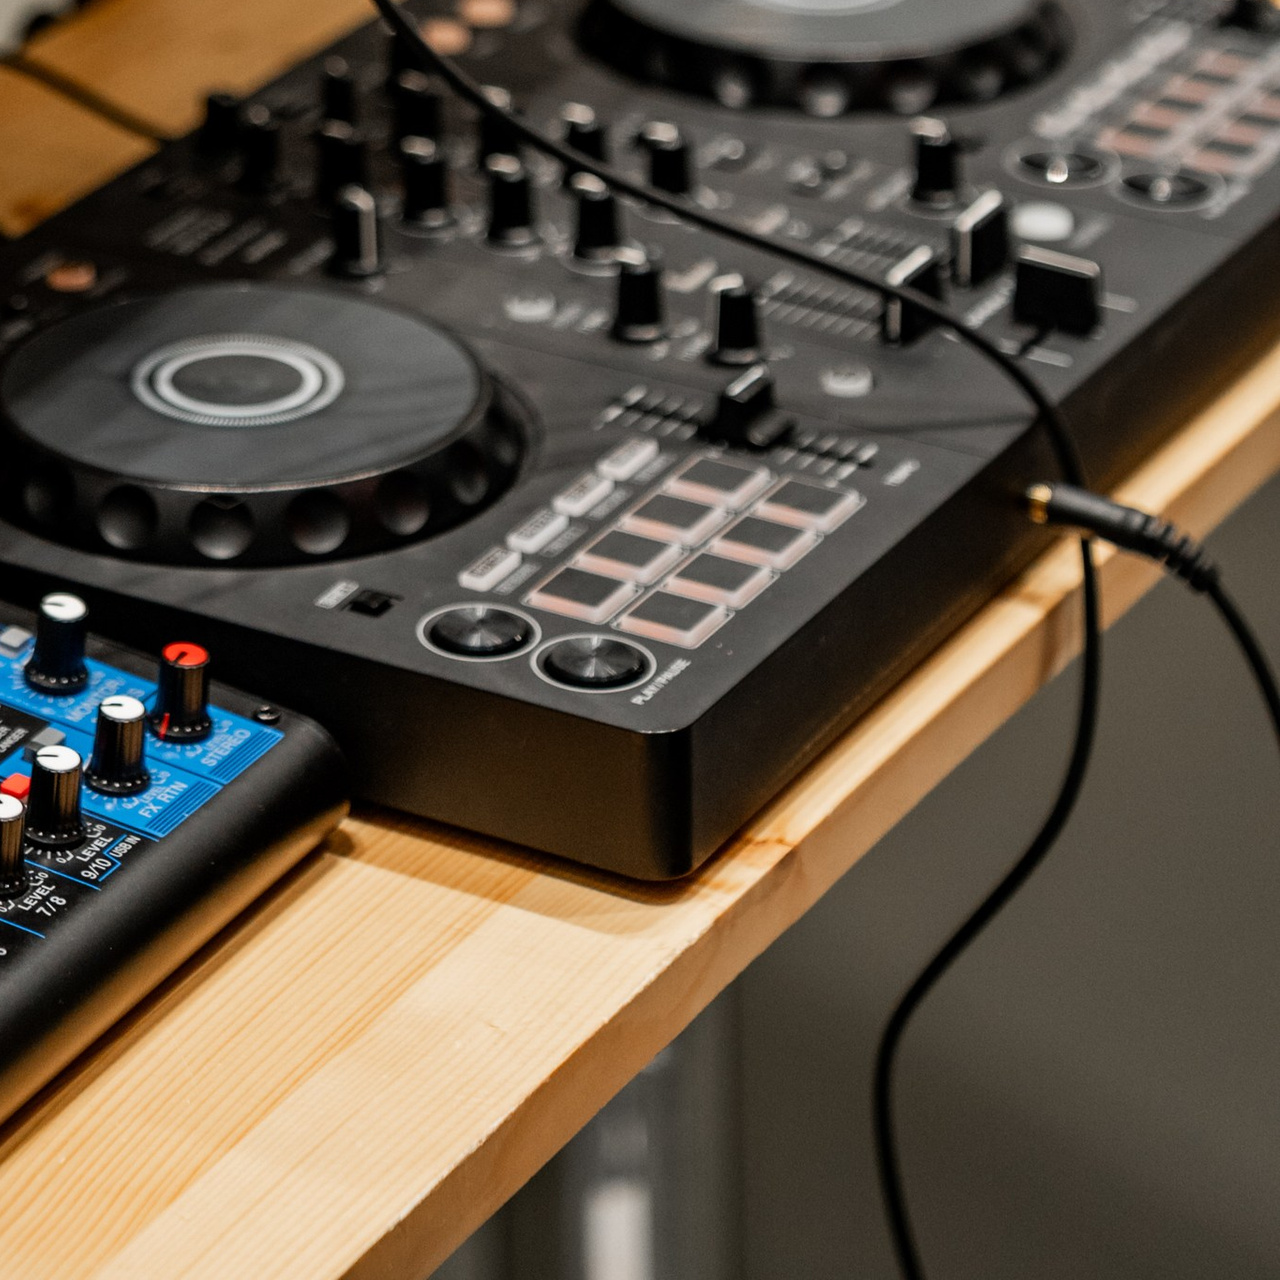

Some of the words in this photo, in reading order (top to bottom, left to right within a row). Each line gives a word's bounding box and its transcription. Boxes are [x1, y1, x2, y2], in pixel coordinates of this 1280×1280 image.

[200, 728, 252, 767] STEREO
[138, 801, 164, 819] FX
[156, 780, 189, 803] RTN
[75, 836, 114, 862] LEVEL
[109, 841, 133, 858] USB
[125, 834, 141, 845] IN
[80, 858, 112, 880] 9/10
[18, 883, 56, 911] LEVEL
[35, 895, 67, 917] 7/8
